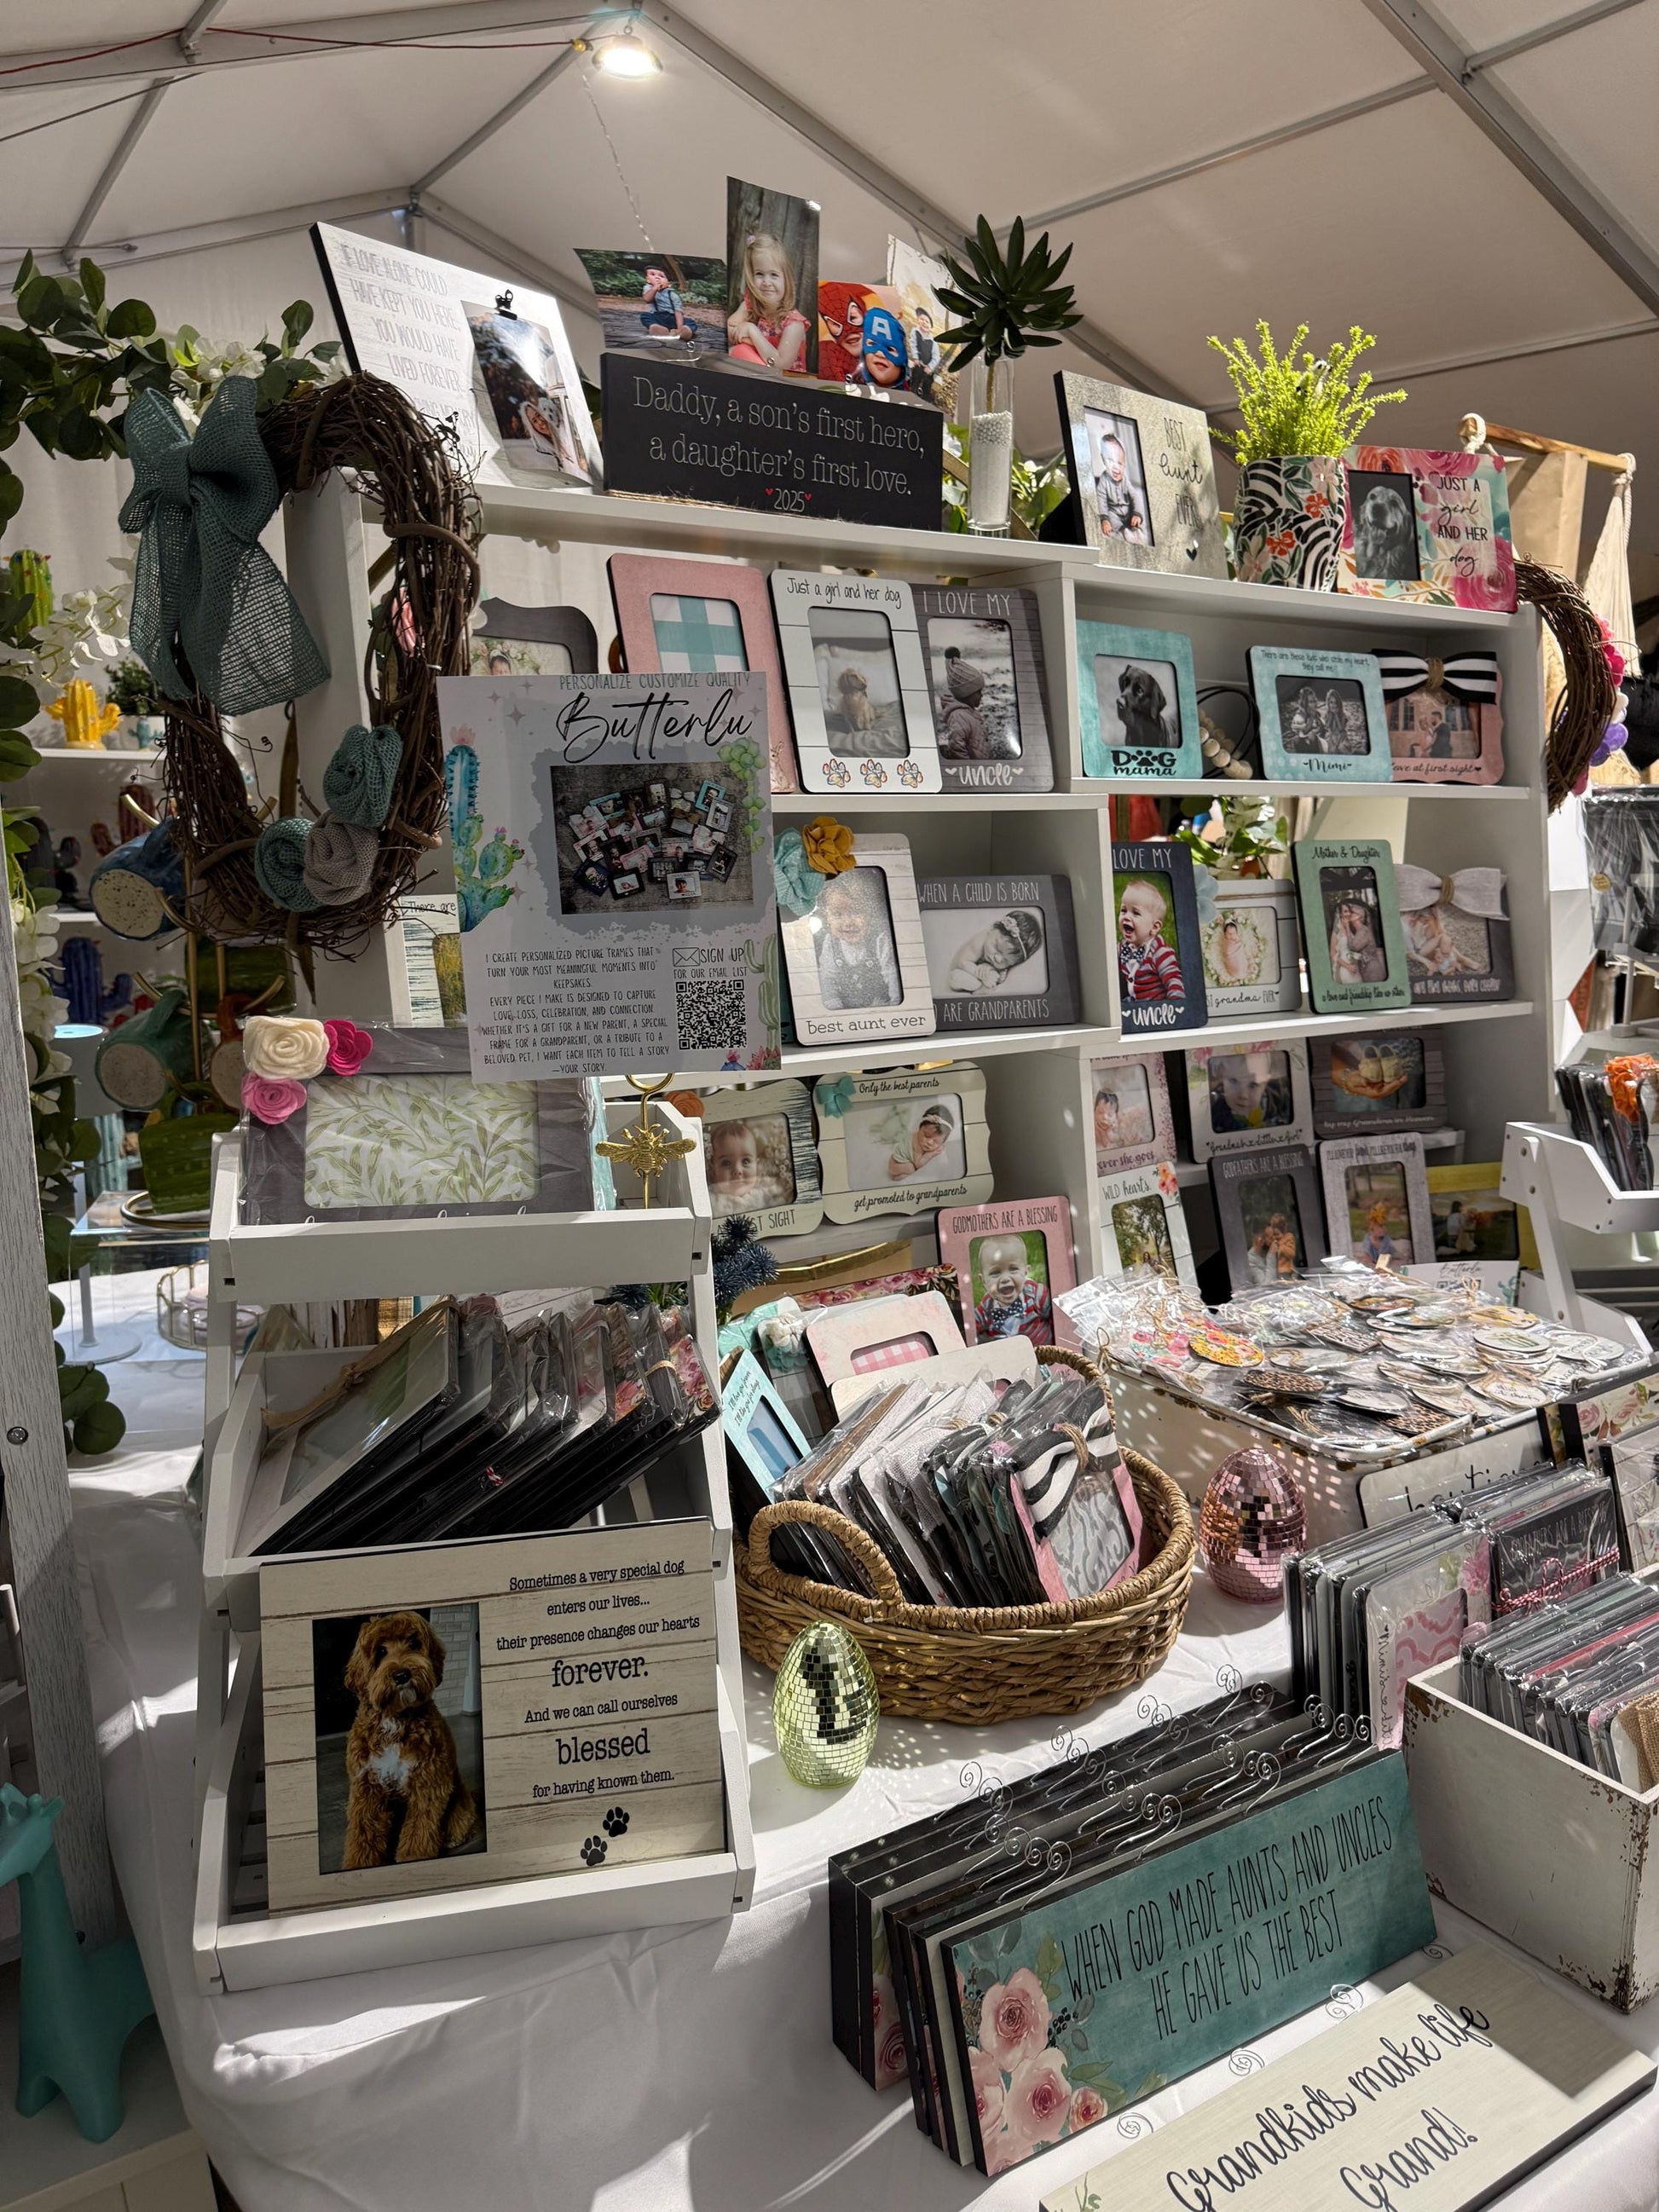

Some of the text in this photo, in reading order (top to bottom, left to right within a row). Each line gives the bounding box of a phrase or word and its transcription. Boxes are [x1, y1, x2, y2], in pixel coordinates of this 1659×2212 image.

[633, 376, 925, 459] Daddy, a son's first hero,
[1164, 418, 1186, 451] BEST
[650, 433, 911, 494] a daughter's first love.
[1437, 476, 1481, 492] JUST A
[773, 489, 806, 512] 2025
[1438, 500, 1479, 525] girl
[1438, 526, 1488, 541] AND HER
[1449, 548, 1478, 577] dog
[787, 577, 901, 609] Just a girl and her dog
[923, 591, 1010, 615] I LOVE MY
[560, 672, 749, 690] PERSONALIZE CUSTOMIZE QUALITY
[556, 688, 753, 763] Butterlu
[1113, 766, 1176, 776] mama
[1309, 759, 1347, 773] Mimi
[1391, 762, 1474, 776] ove at first sight
[1113, 848, 1172, 869] LOVE MY
[1312, 846, 1380, 863] Mother & Daughter
[917, 883, 1039, 903] WHEN A CHILD IS BORN
[408, 901, 456, 913] There are
[493, 953, 517, 962] CREATE
[522, 950, 571, 962] PERSONALIZED
[575, 949, 604, 959] PICTURE
[608, 947, 633, 958] FRAMES
[638, 947, 654, 956] THAT
[700, 947, 744, 963] SIGN UP
[487, 961, 656, 978] TURN YOUR MOST MEANINGFUL MOMENTS INTO
[673, 967, 748, 979] FOR OUR EMAIL LIST
[1215, 988, 1261, 1008] grandma
[944, 1003, 962, 1022] ARE
[968, 999, 1049, 1022] GRANDPARENTS
[806, 1016, 926, 1035] best aunt ever
[859, 1077, 939, 1096] Only the best parents
[854, 1183, 967, 1212] get promoted to grandparents
[1102, 1184, 1119, 1200] WILD
[768, 1209, 795, 1229] SIGHT
[952, 1205, 1057, 1234] GODMOTHERS ARE A BLESSING
[510, 1560, 685, 1591] Sometimes a very special dog
[547, 1594, 650, 1615] enters our lives...
[496, 1616, 700, 1650] their presence changes our hearts
[552, 1656, 649, 1687] forever.
[524, 1694, 678, 1724] And we can call ourselves
[556, 1728, 650, 1764] blessed
[533, 1770, 675, 1799] for having known them.
[1061, 1795, 1392, 2002] WHEN GOD MADE AUNTS AND UNCLES
[1149, 1889, 1344, 2041] HE GAVE US THE BEST
[1166, 2003, 1494, 2212] Grandkids make life
[1339, 2106, 1478, 2212] Grand!
